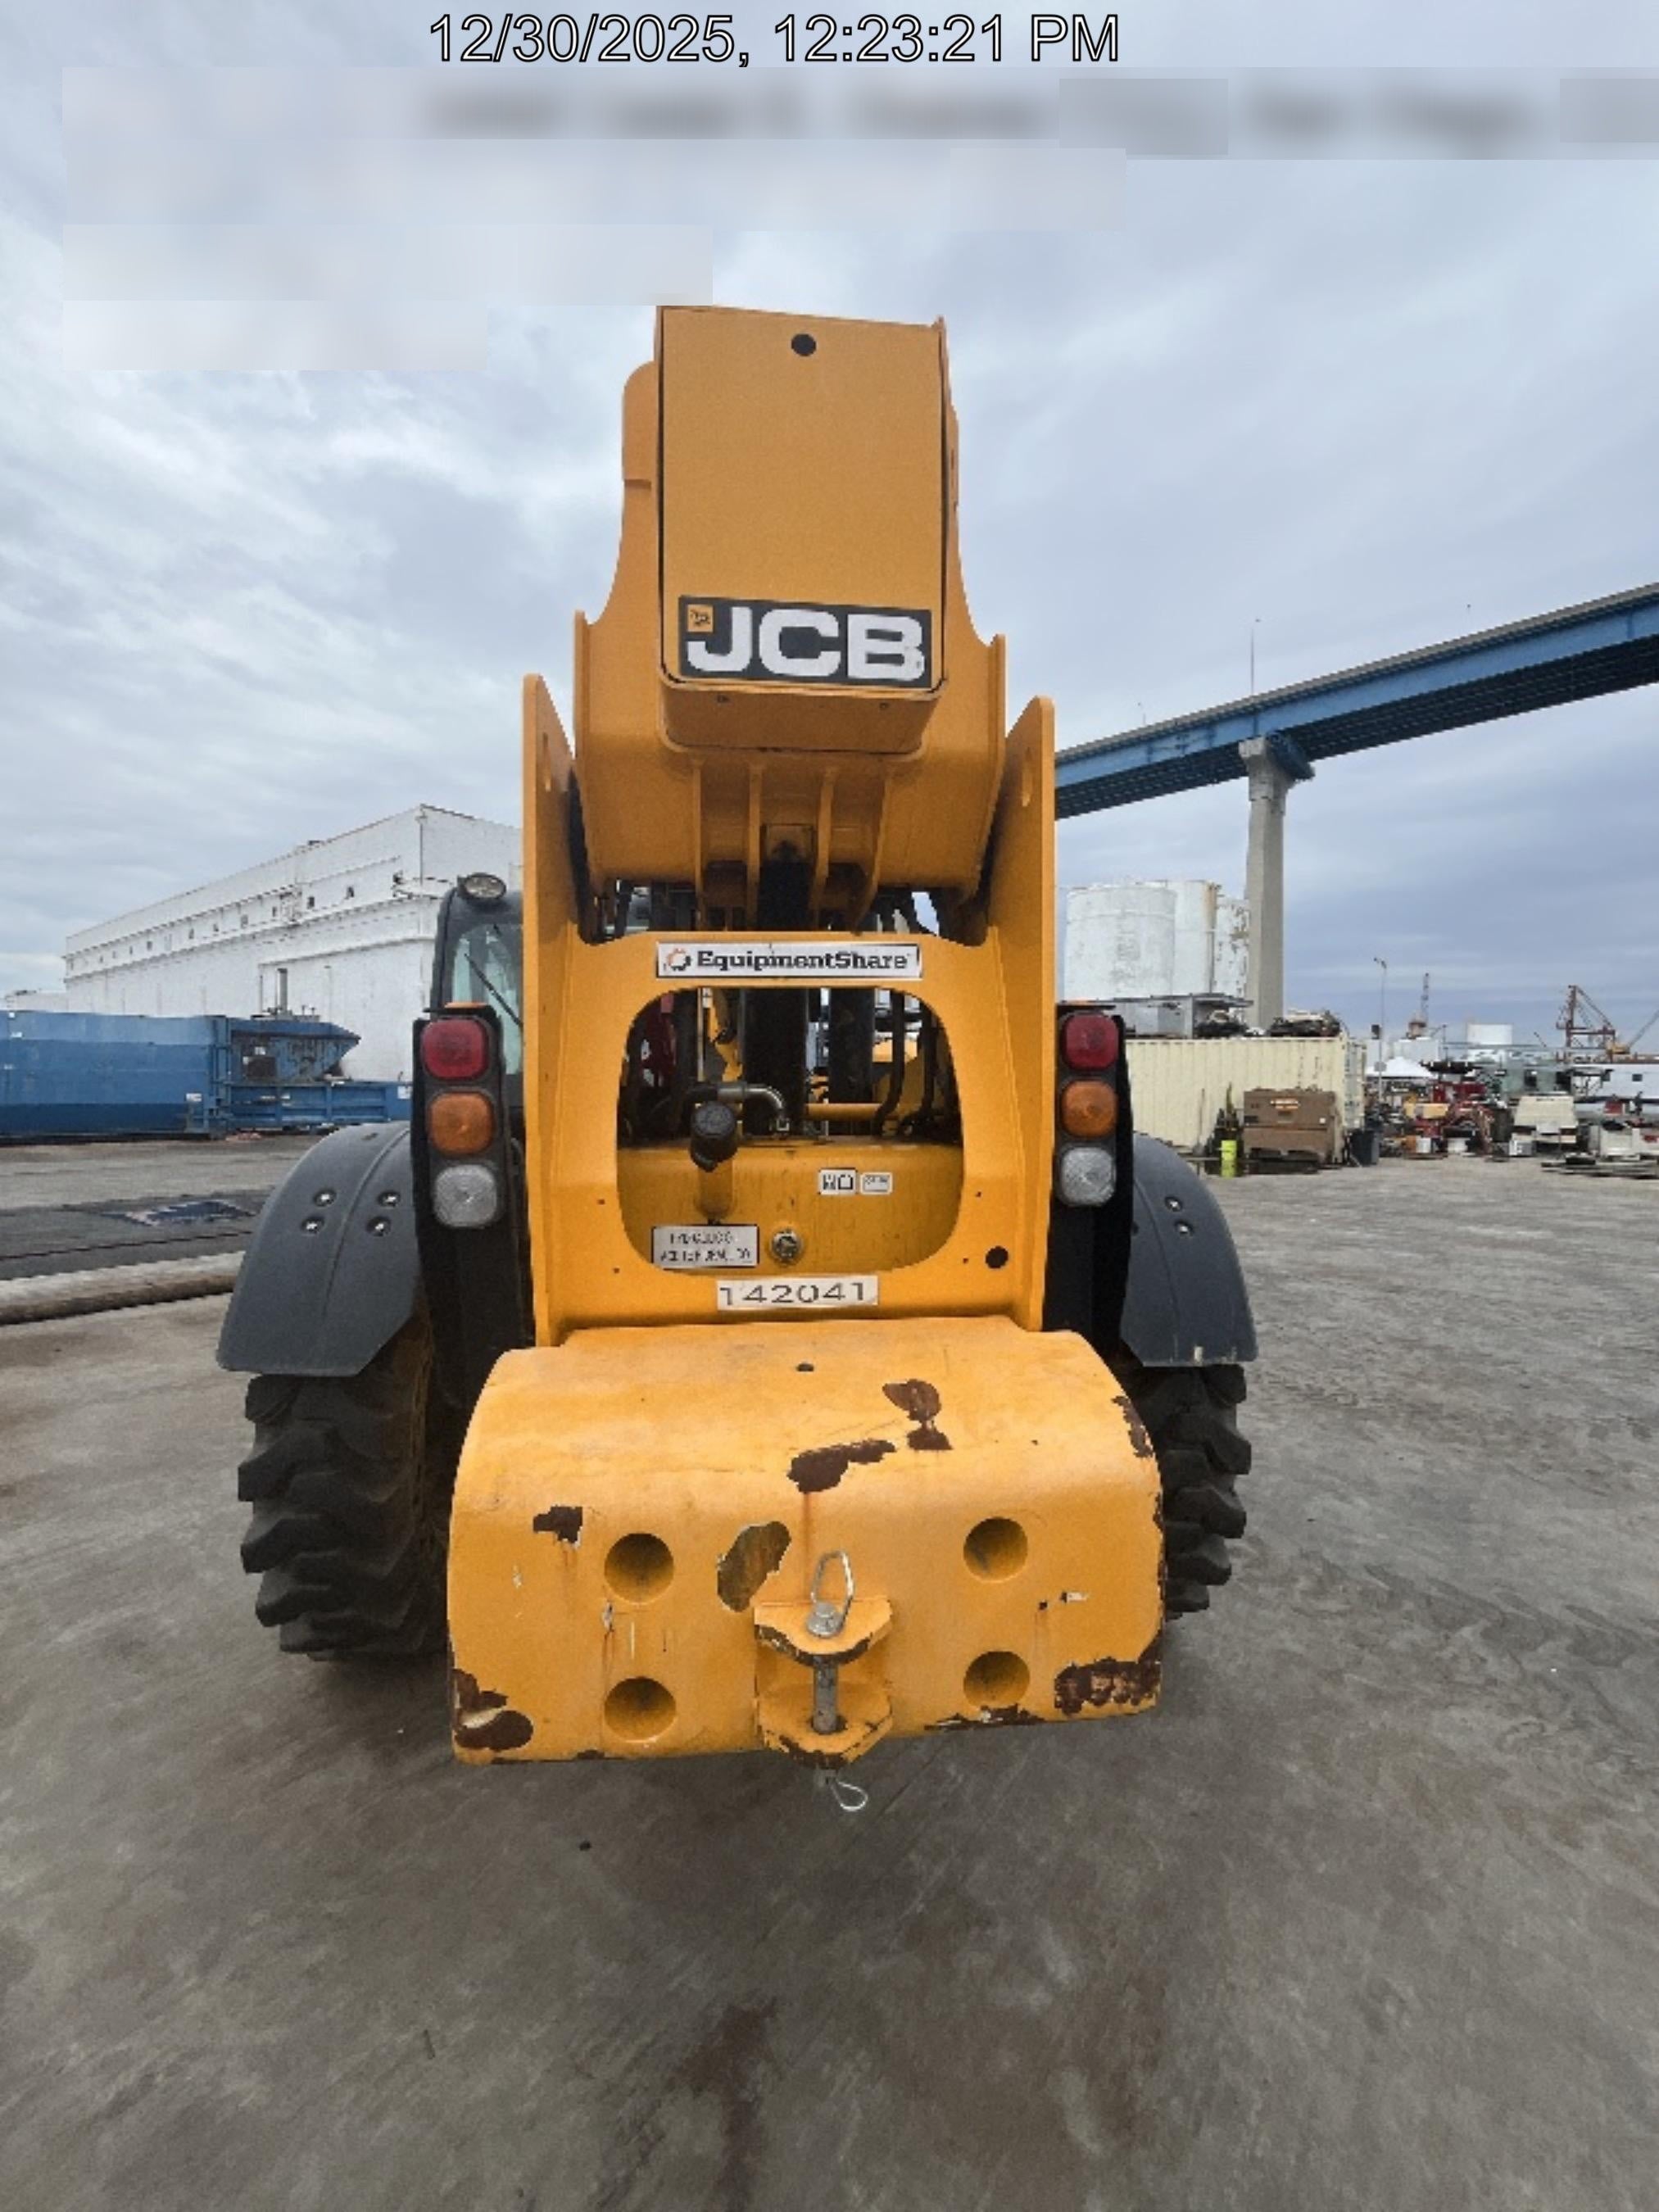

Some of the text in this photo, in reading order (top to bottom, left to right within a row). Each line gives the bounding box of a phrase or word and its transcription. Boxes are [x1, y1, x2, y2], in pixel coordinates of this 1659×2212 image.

[687, 606, 925, 682] JCB
[696, 950, 909, 971] EquipmentShare
[719, 1282, 864, 1306] 142041
